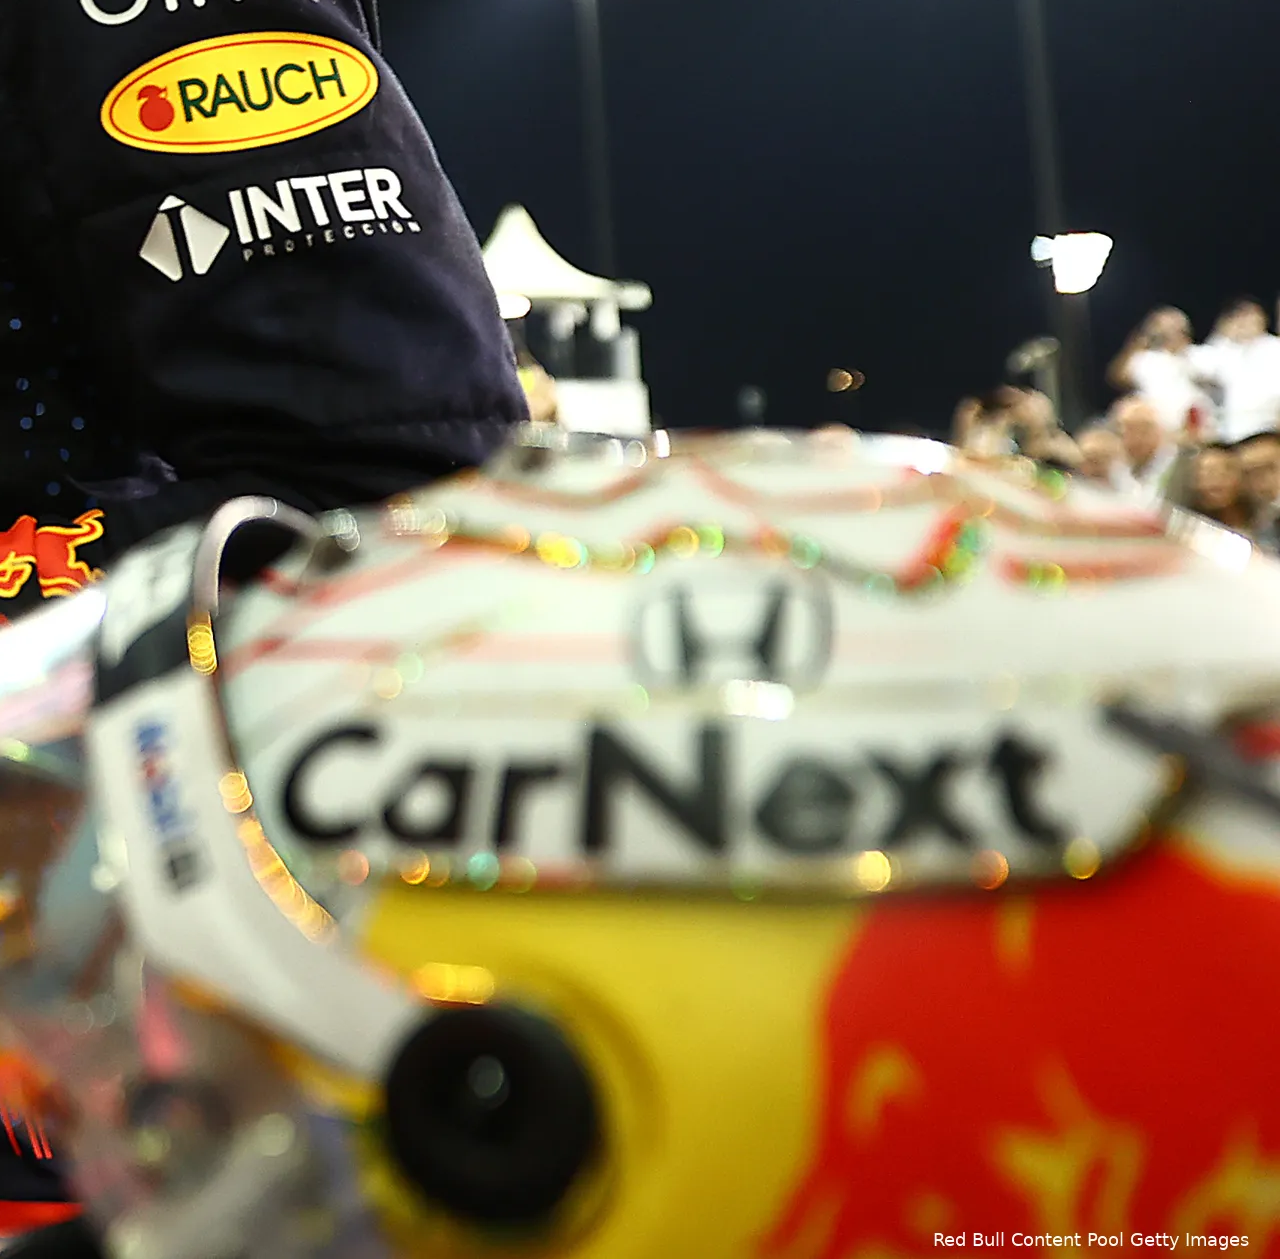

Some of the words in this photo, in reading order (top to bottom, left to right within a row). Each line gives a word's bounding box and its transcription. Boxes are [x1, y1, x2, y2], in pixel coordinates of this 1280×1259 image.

[178, 57, 346, 123] RAUCH
[228, 167, 413, 244] INTER
[280, 715, 1075, 857] CarNext
